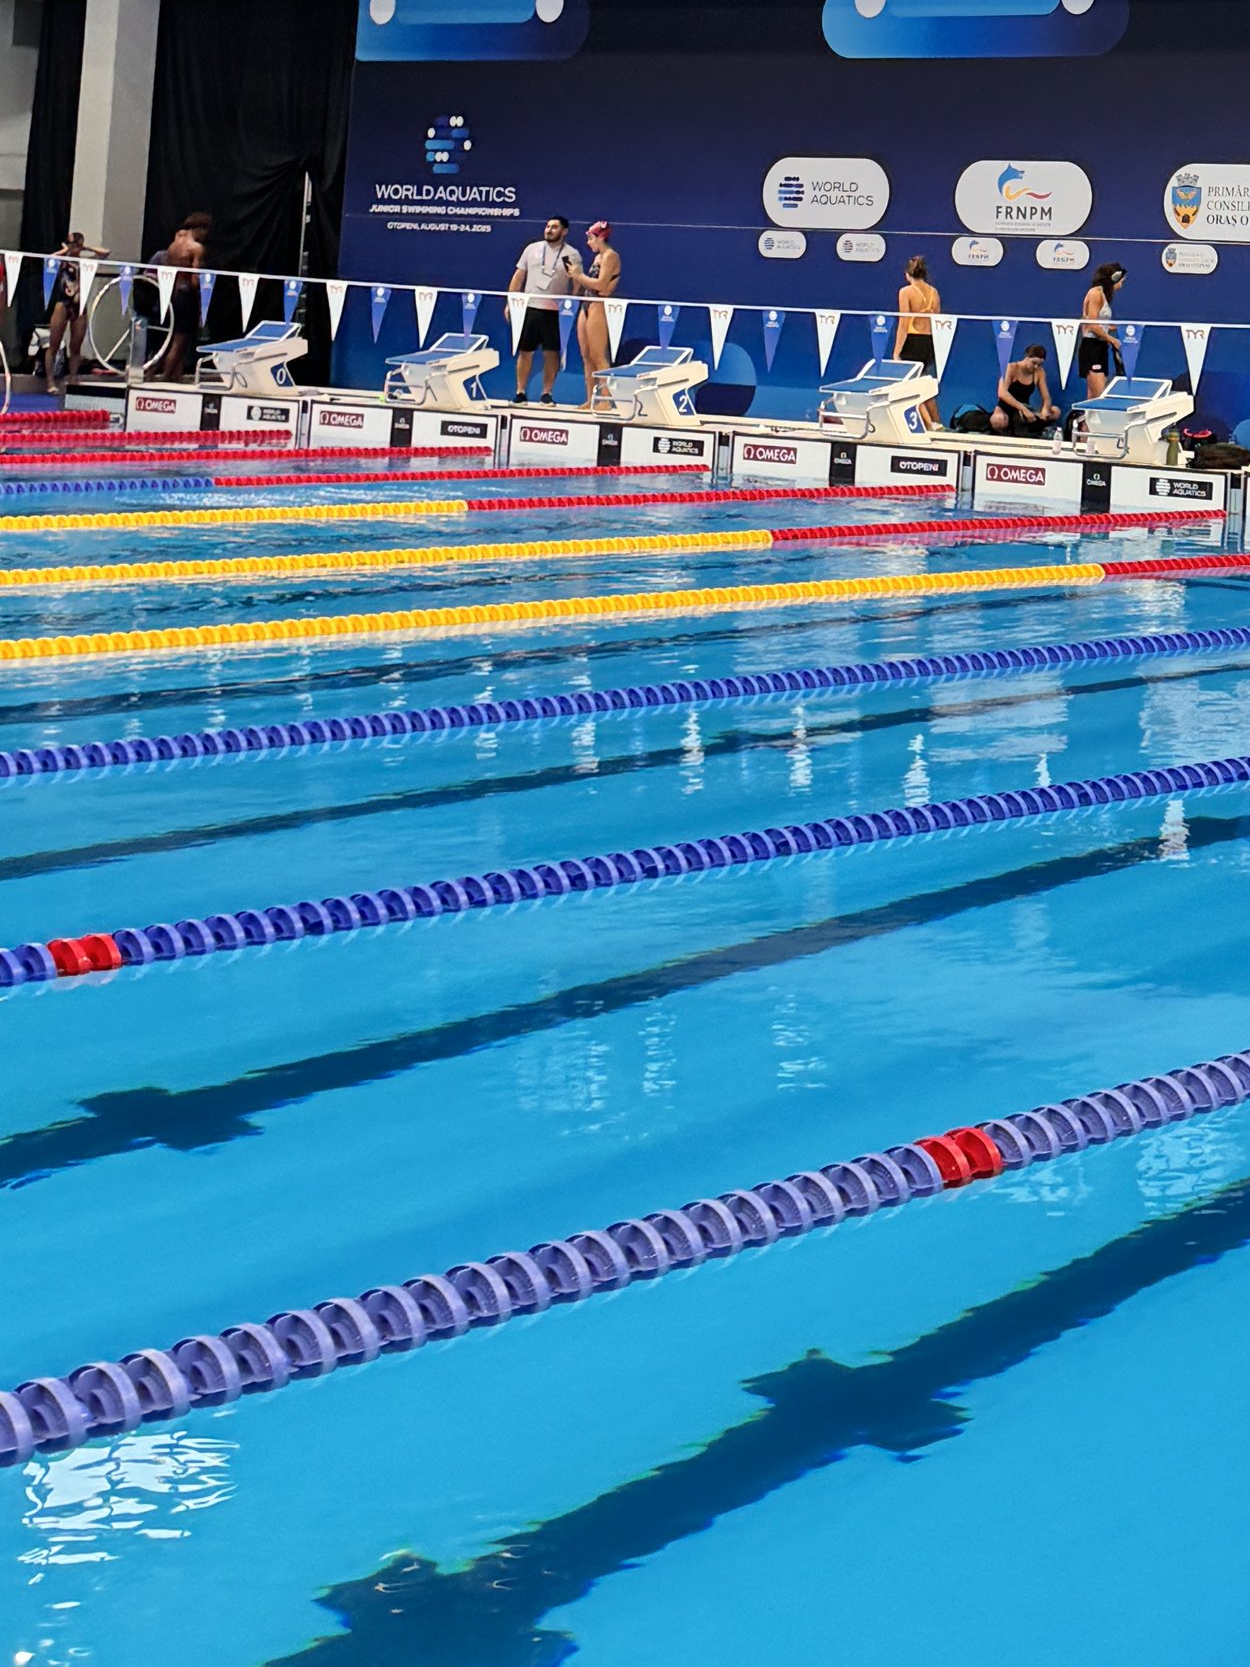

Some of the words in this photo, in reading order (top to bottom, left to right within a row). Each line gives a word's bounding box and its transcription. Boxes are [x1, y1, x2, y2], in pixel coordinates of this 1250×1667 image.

[811, 181, 859, 193] WORLD
[376, 184, 434, 200] WORLD
[434, 185, 517, 203] AQUATICS
[810, 194, 874, 206] AQUATICS
[369, 204, 401, 213] JUNIOR
[995, 205, 1052, 221] FRNPM
[608, 303, 623, 313] TYR
[713, 309, 729, 320] TYR
[818, 314, 836, 324] TYR
[934, 320, 952, 331] TYR
[1055, 325, 1074, 335] TYR
[1185, 329, 1205, 340] TYR
[276, 367, 286, 385] 0
[470, 381, 477, 398] 1
[144, 399, 176, 413] OMEGA
[678, 395, 687, 413] 2
[329, 414, 364, 428] OMEGA
[908, 411, 918, 430] 3
[531, 430, 568, 444] OMEGA
[755, 449, 797, 463] OMEGA
[899, 461, 939, 472] OTOPENI
[1000, 467, 1045, 483] OMEGA
[1172, 482, 1199, 491] WORLD
[1172, 488, 1207, 498] AQUATICS
